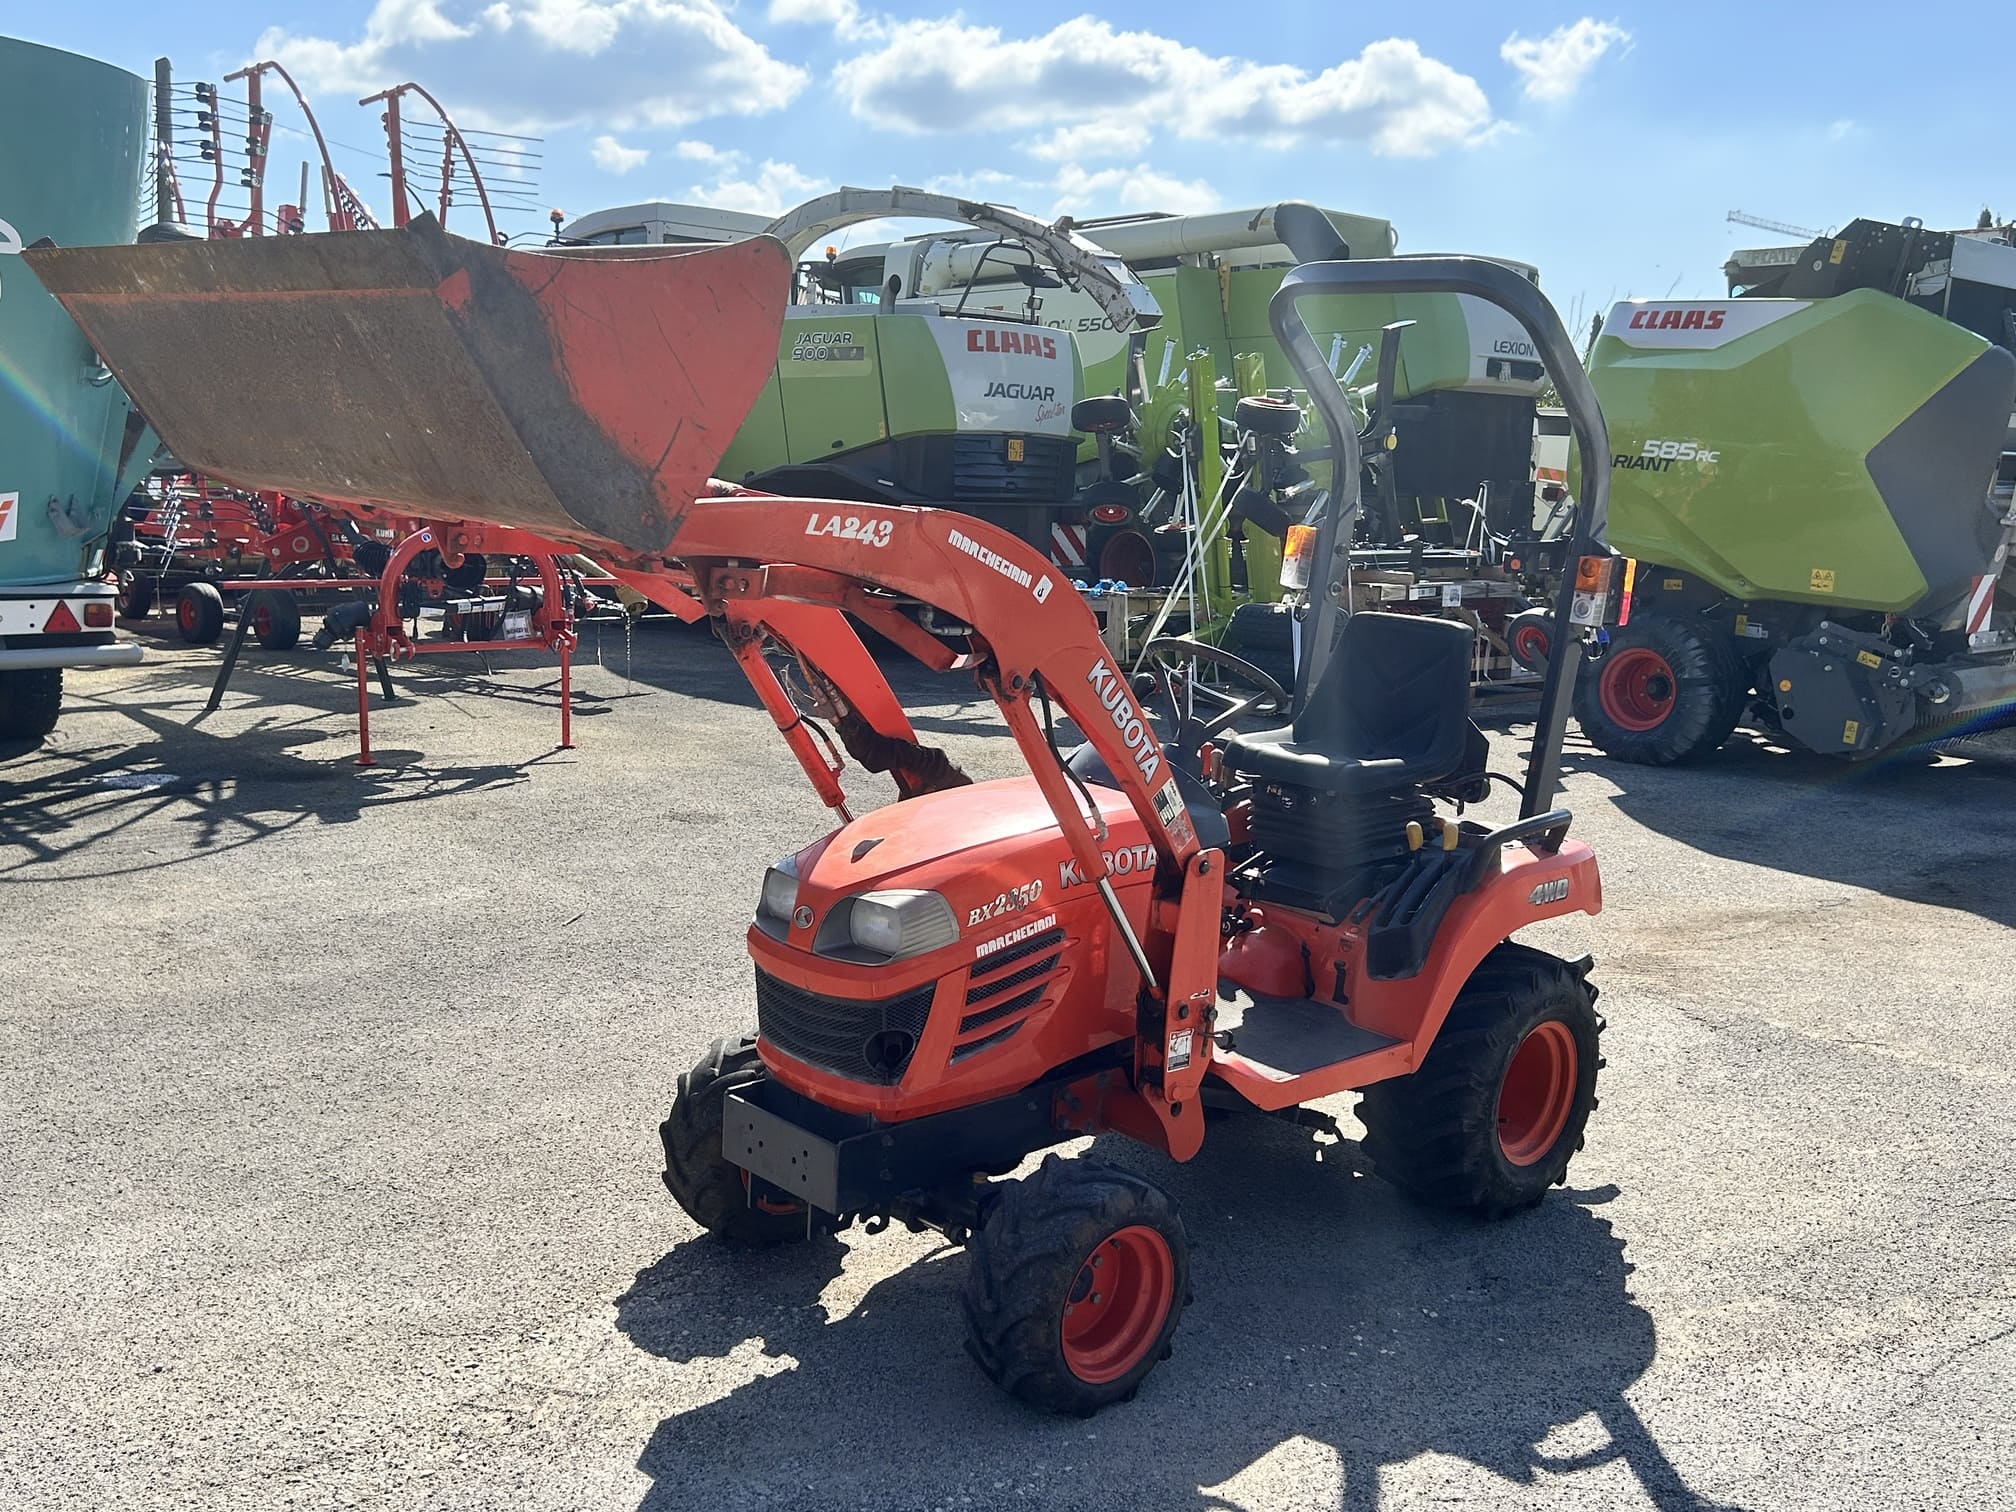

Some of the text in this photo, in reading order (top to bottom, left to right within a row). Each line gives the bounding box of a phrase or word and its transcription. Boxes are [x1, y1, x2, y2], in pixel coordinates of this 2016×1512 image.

[1629, 310, 1727, 330] CLAAS
[792, 346, 828, 361] 900
[796, 332, 853, 345] JAGUAR
[967, 329, 1057, 360] CLAAS
[1494, 339, 1534, 357] LEXION
[984, 382, 1055, 402] JAGUAR
[805, 513, 893, 548] LA243
[948, 528, 1033, 589] MARCHEGIANI
[1086, 656, 1161, 786] KUBOTA
[1059, 844, 1157, 889] KBOTA
[966, 879, 1043, 928] BX2350
[1528, 878, 1569, 906] 4WD
[976, 913, 1057, 959] MARCHEGIANI
